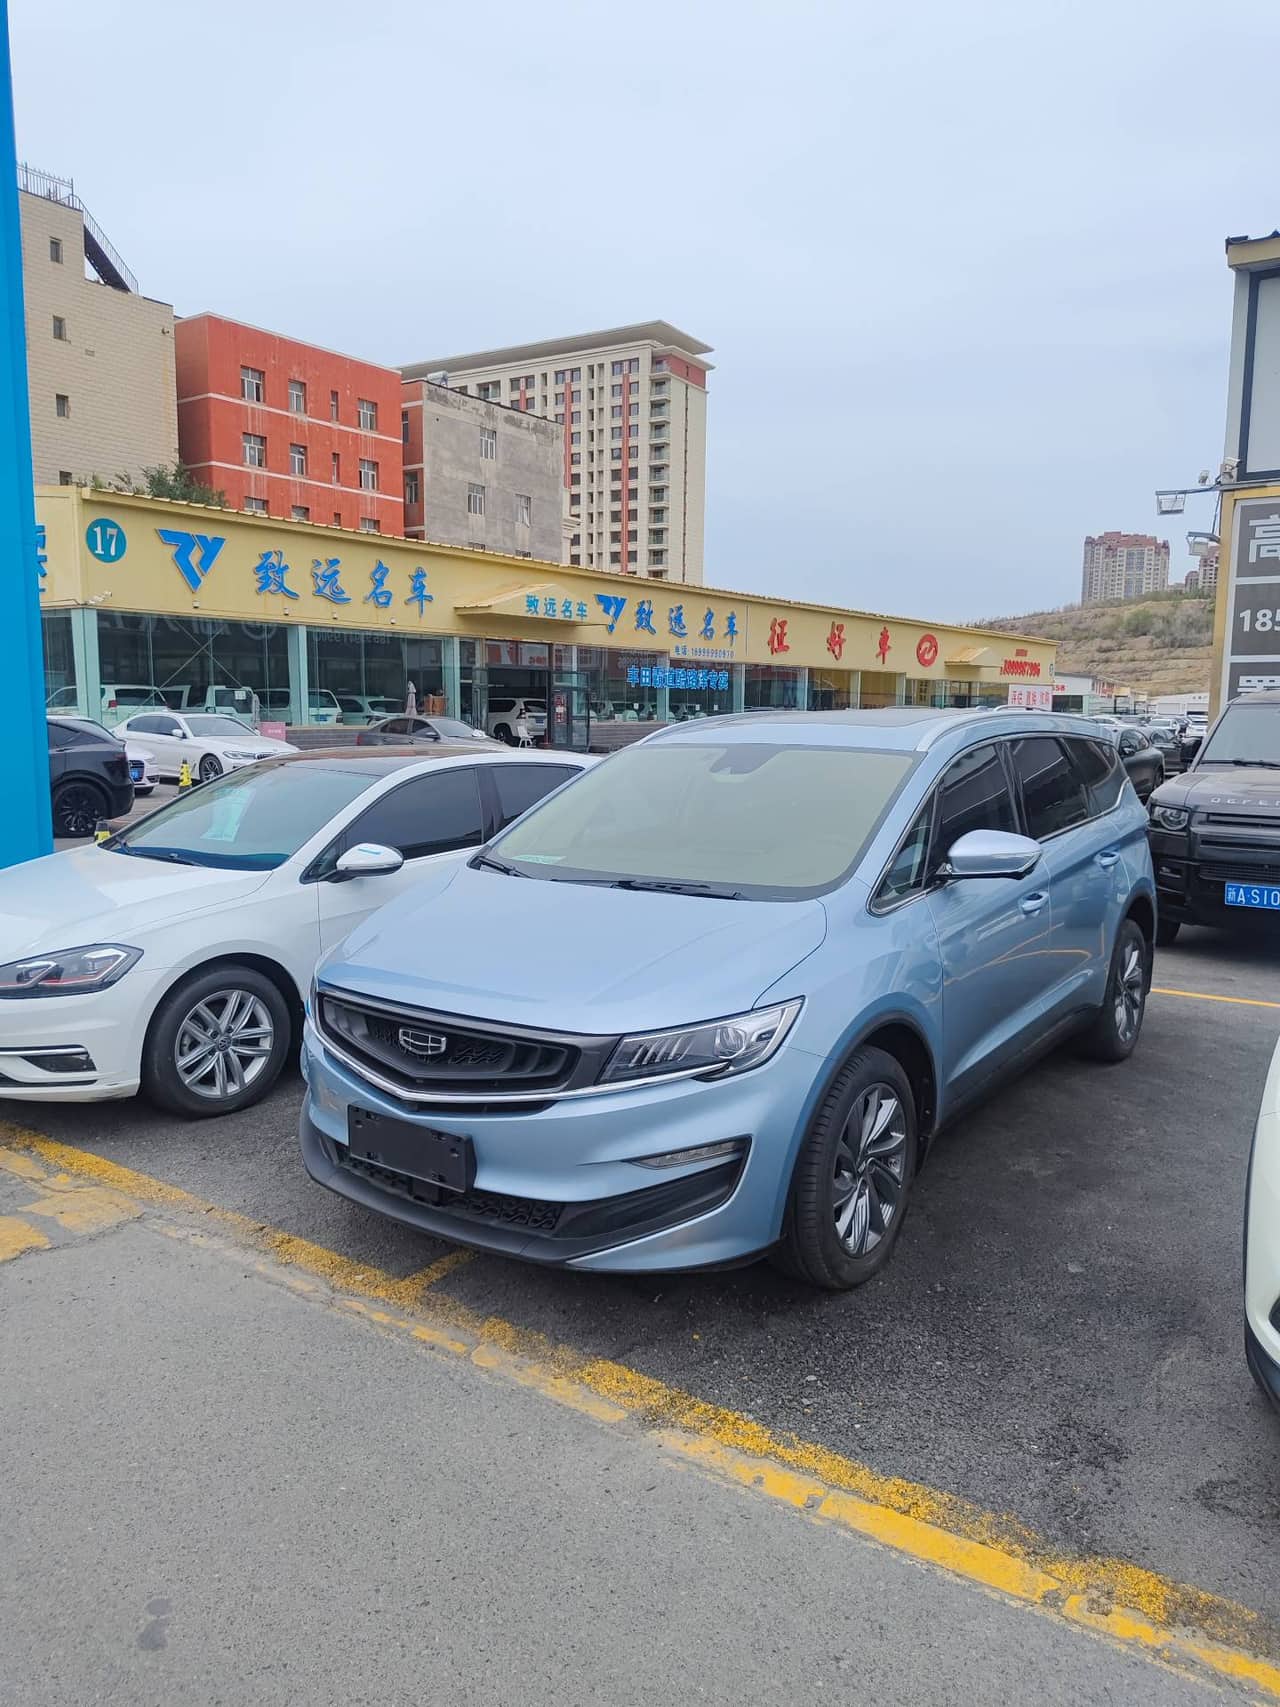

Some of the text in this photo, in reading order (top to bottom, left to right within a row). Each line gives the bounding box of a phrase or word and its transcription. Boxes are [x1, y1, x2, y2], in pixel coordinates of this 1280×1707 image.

[92, 526, 119, 556] 17
[254, 550, 434, 617] 致远名车
[525, 594, 588, 620] 致远名车
[634, 600, 738, 646] 致远名车
